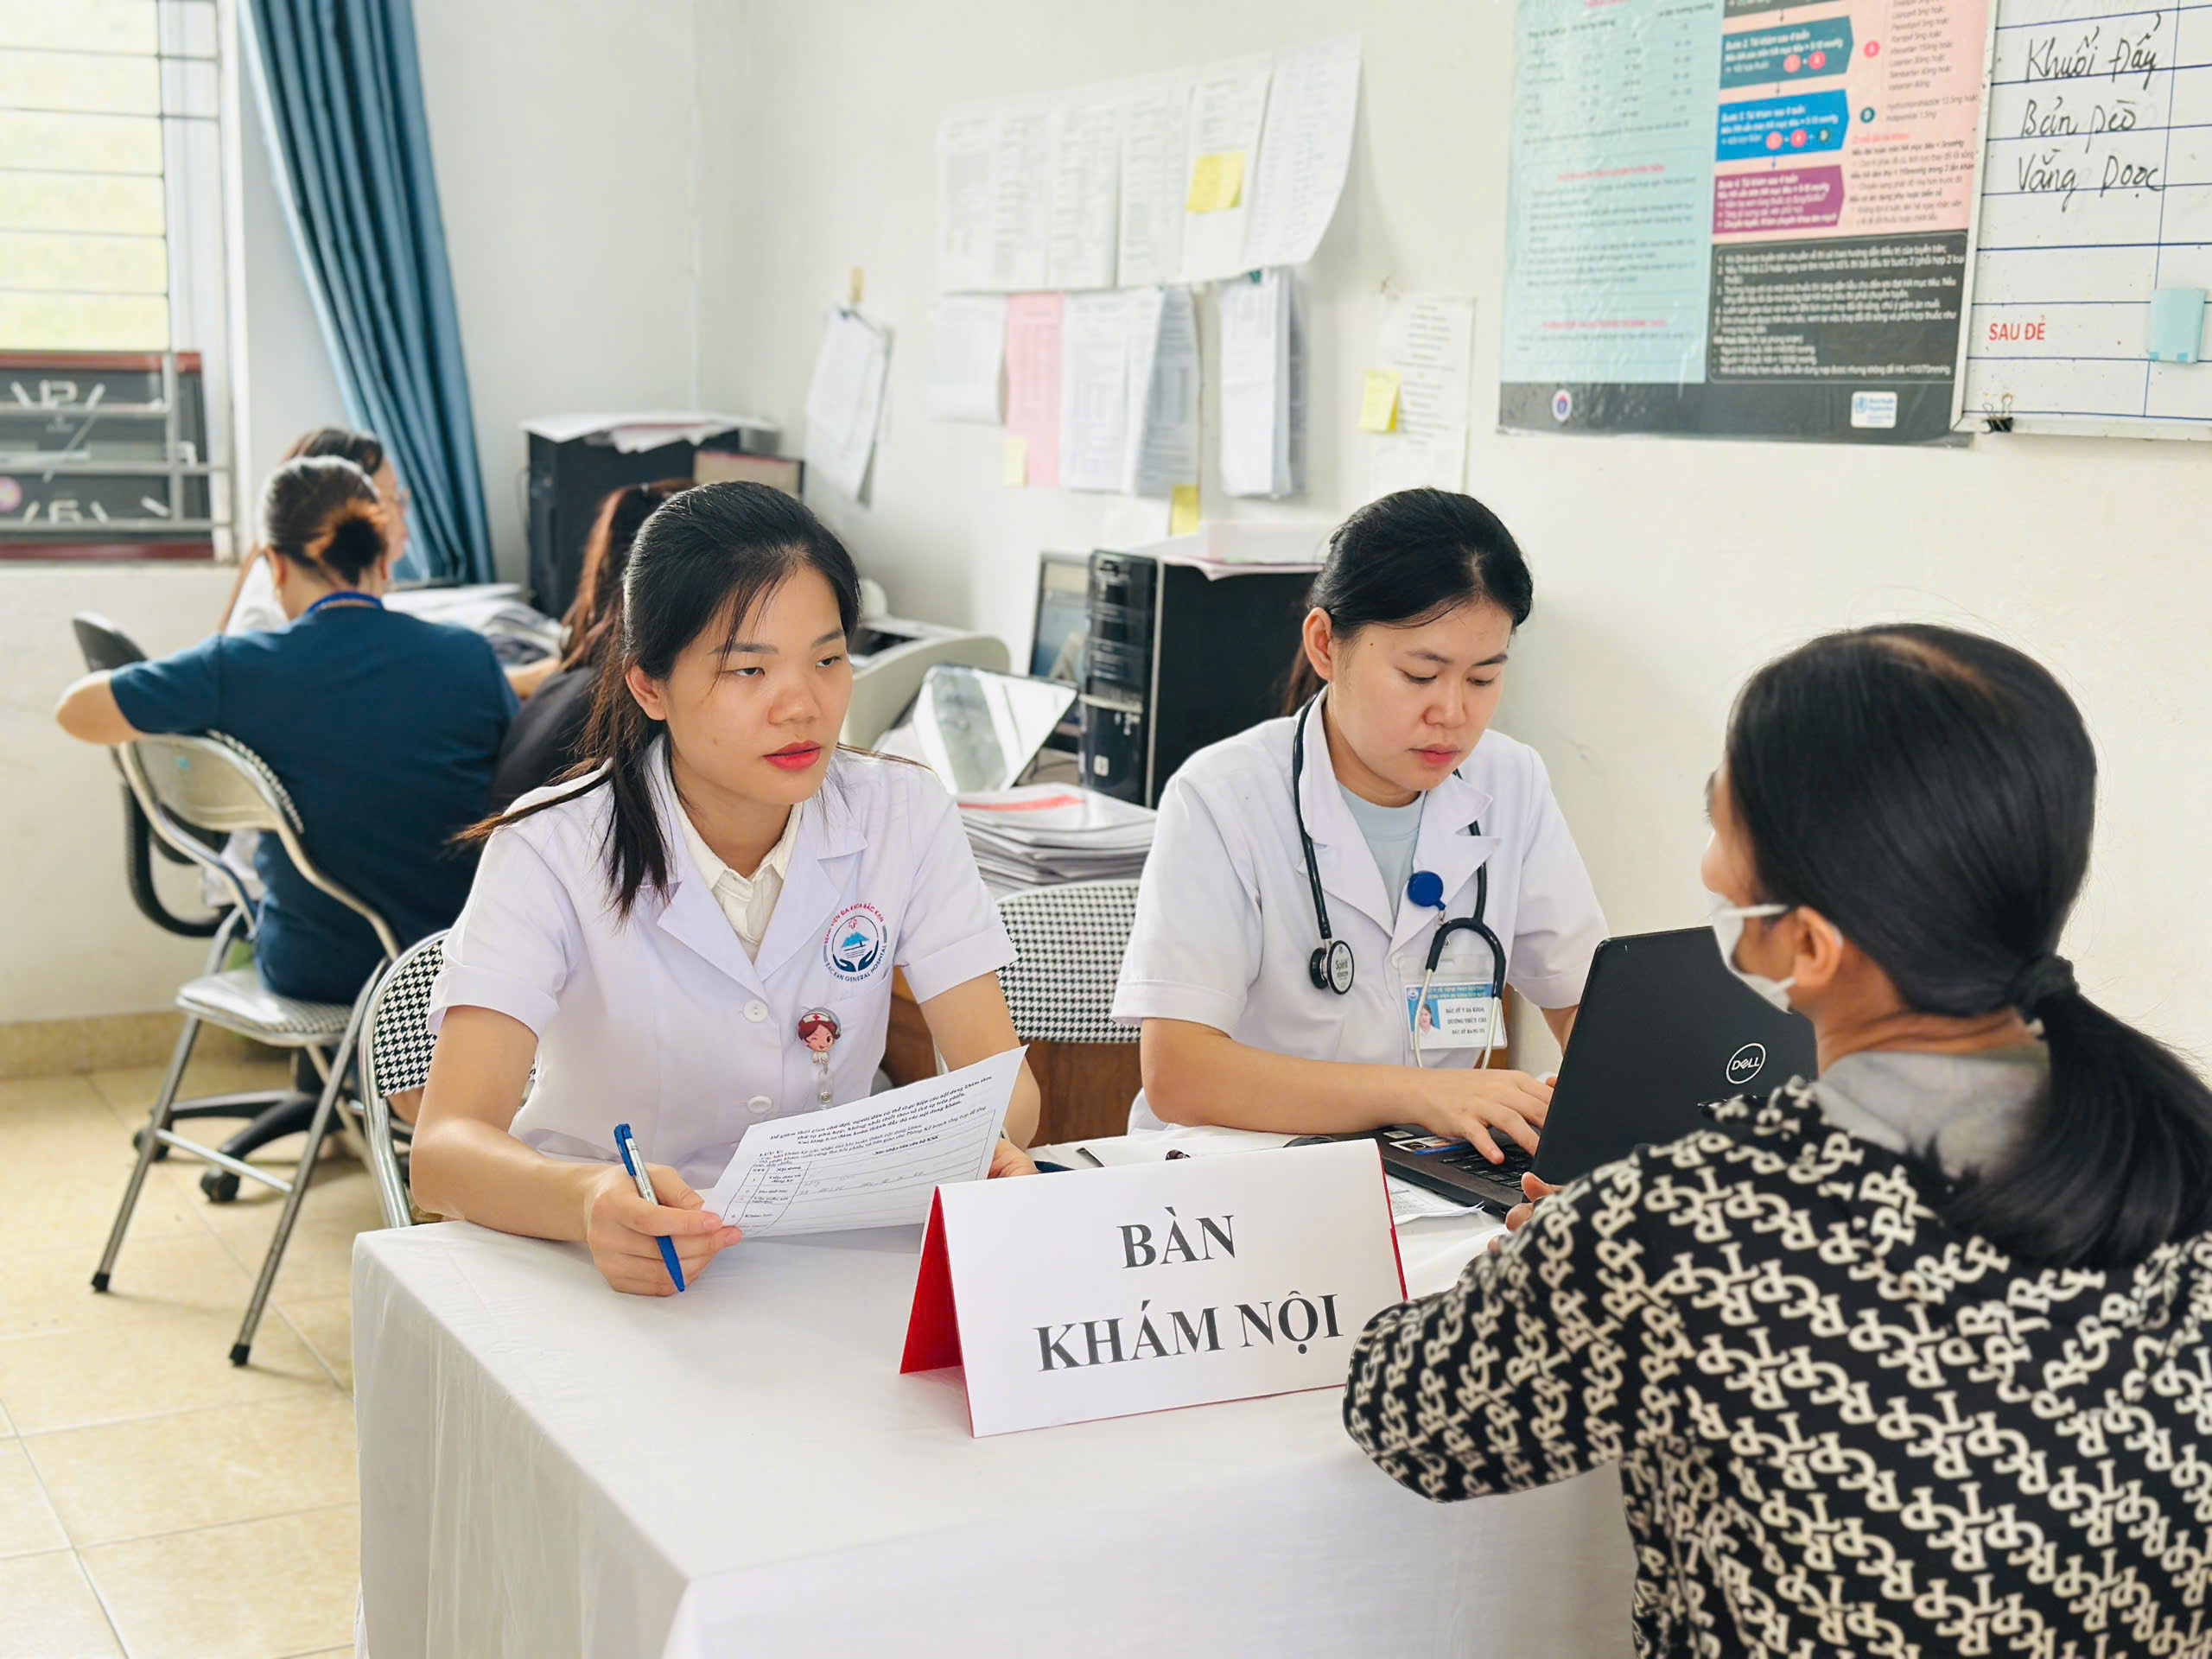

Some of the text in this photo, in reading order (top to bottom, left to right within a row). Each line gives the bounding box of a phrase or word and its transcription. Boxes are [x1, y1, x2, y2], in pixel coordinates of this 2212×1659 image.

[2025, 12, 2162, 91] Khuổi Đẩy
[2020, 96, 2078, 138] Bản
[1989, 321, 2021, 341] SAU
[1732, 1057, 1759, 1071] DELL
[1117, 1206, 1236, 1269] BÀN
[1033, 1290, 1344, 1372] KHÁM NỘI
